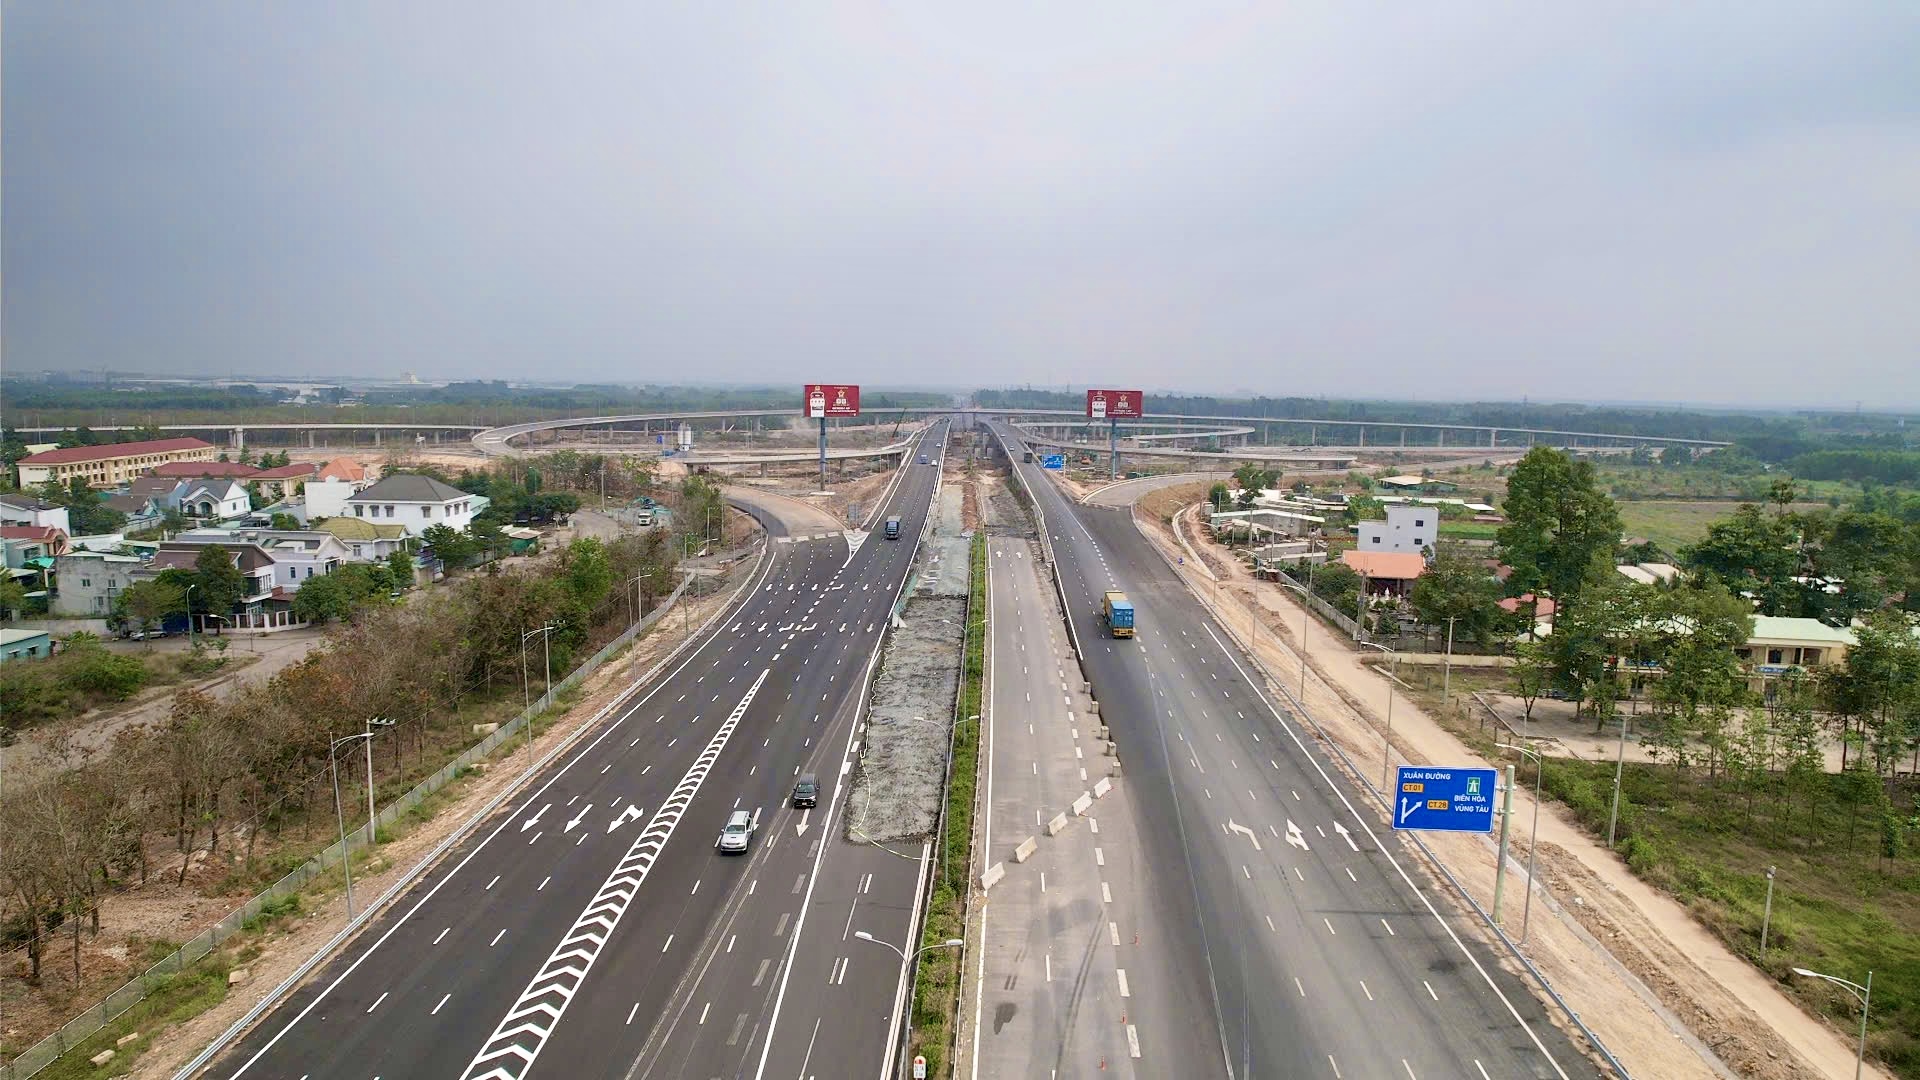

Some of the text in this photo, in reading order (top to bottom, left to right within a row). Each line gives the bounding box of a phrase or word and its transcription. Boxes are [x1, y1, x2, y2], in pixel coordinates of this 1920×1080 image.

[1403, 771, 1424, 779] XUÂN
[1454, 794, 1471, 802] BIÊN
[1454, 804, 1489, 813] VŨNG TÀU
